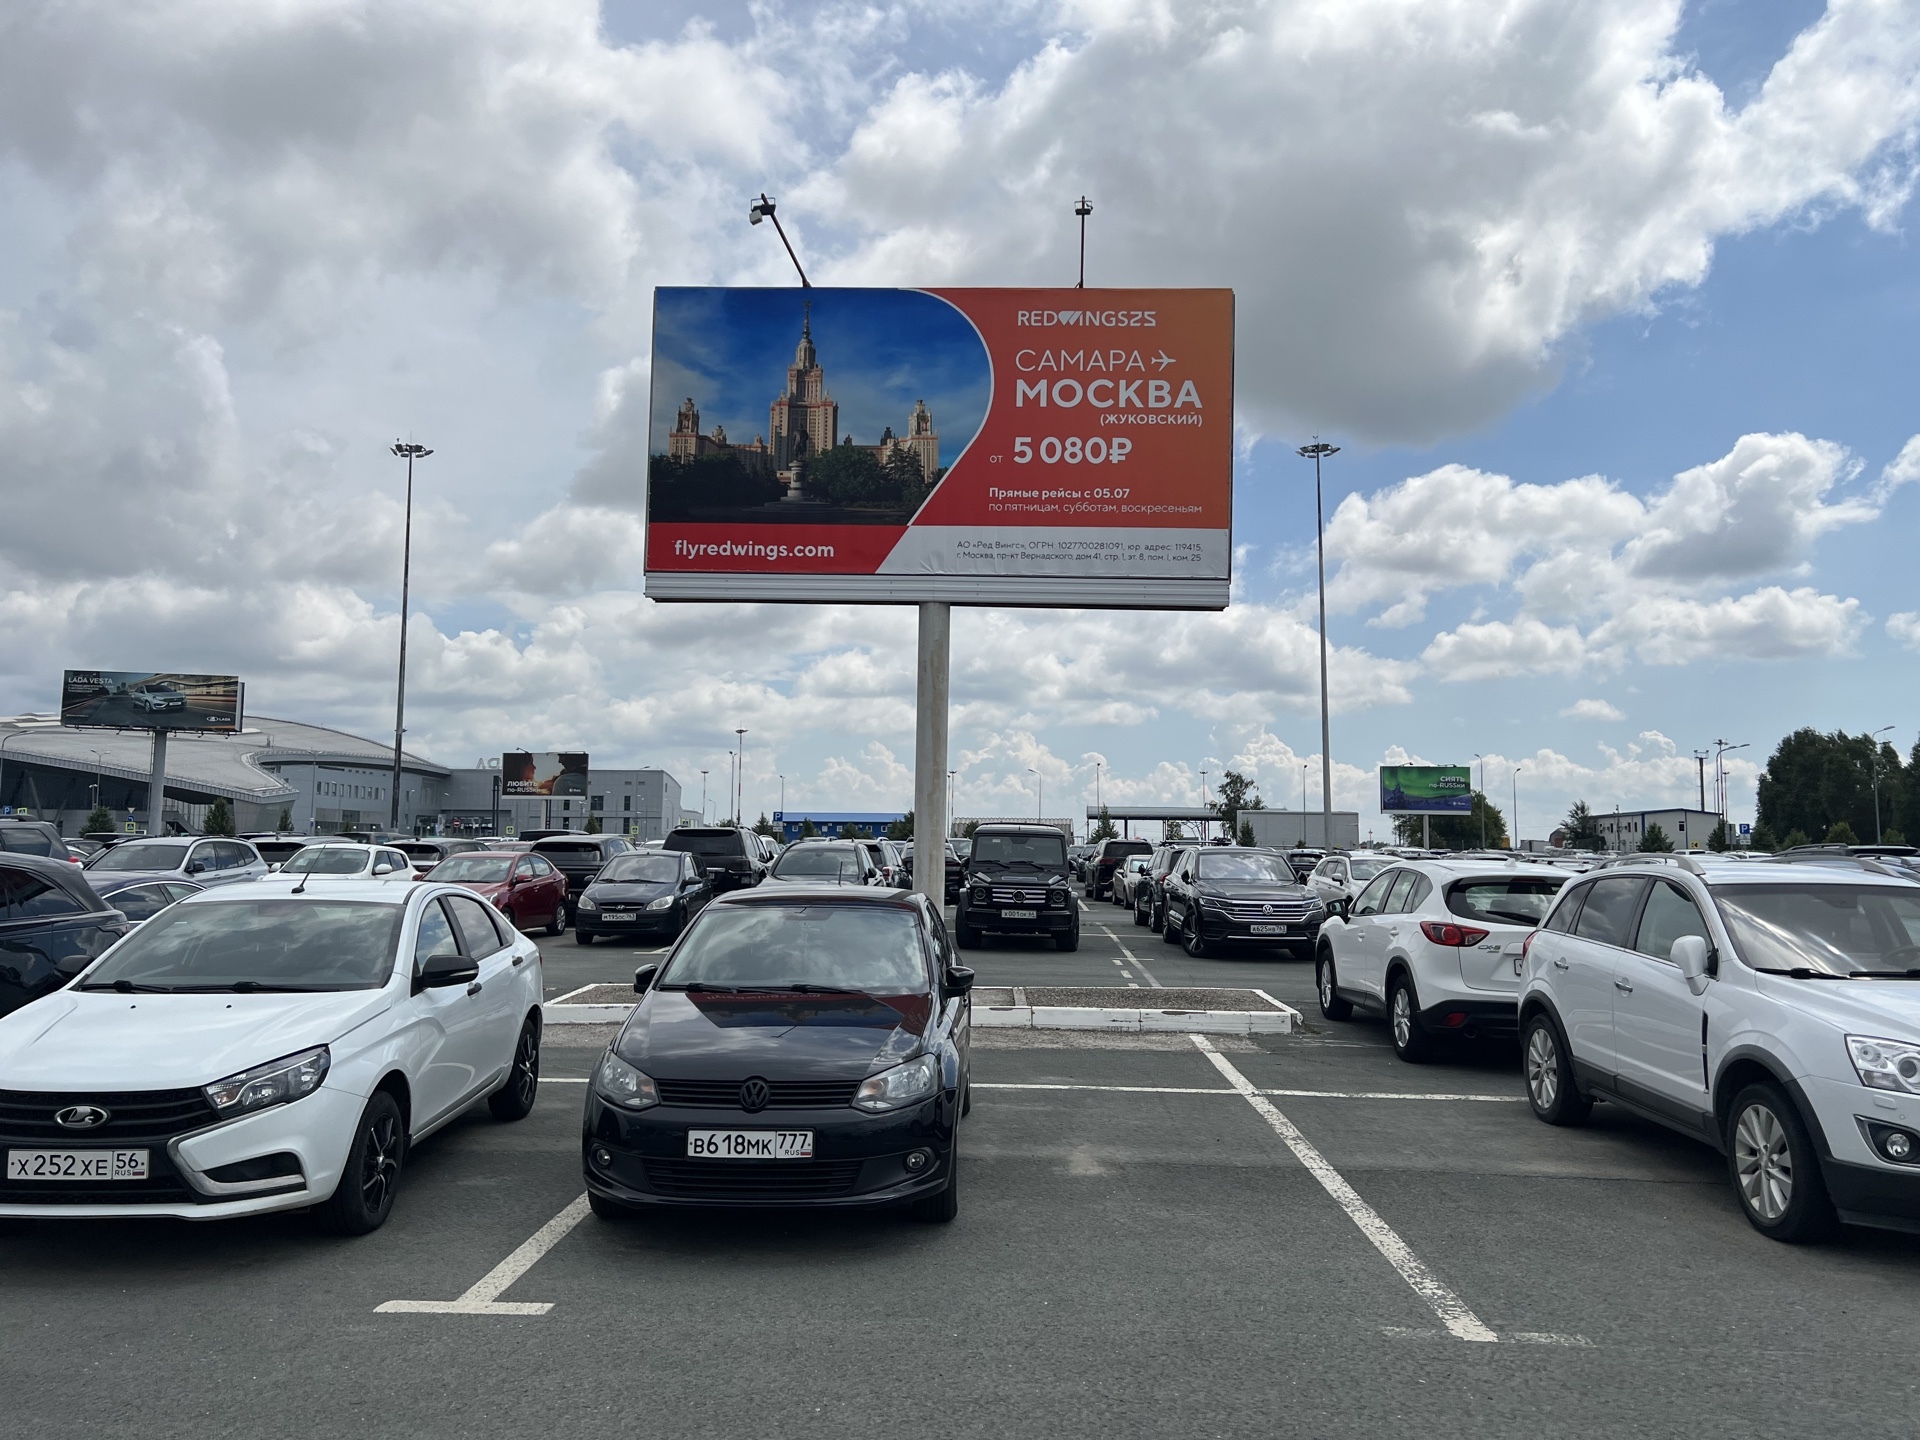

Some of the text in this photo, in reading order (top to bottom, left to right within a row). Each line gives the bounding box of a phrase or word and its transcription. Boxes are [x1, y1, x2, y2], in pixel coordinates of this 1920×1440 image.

[1015, 349, 1146, 372] САМАРА
[1015, 379, 1203, 408] МОСКВА
[1099, 411, 1203, 427] (ЖУКОВСКИЙ)
[989, 487, 1130, 501] Прямые рейсы с 05.07
[988, 501, 1202, 515] по пятницам, субботам, воскресеньям
[674, 539, 835, 560] flyredwings.com
[956, 540, 971, 549] АО
[1144, 544, 1173, 552] адрес:
[962, 551, 995, 560] Москва,
[996, 552, 1019, 561] пр-кт
[1020, 552, 1075, 561] Вернадского,
[1075, 553, 1092, 561] дом
[1190, 553, 1202, 562] 25
[693, 1133, 809, 1155] В618МК 777
[16, 1152, 139, 1176] Х252ХЕ 56
